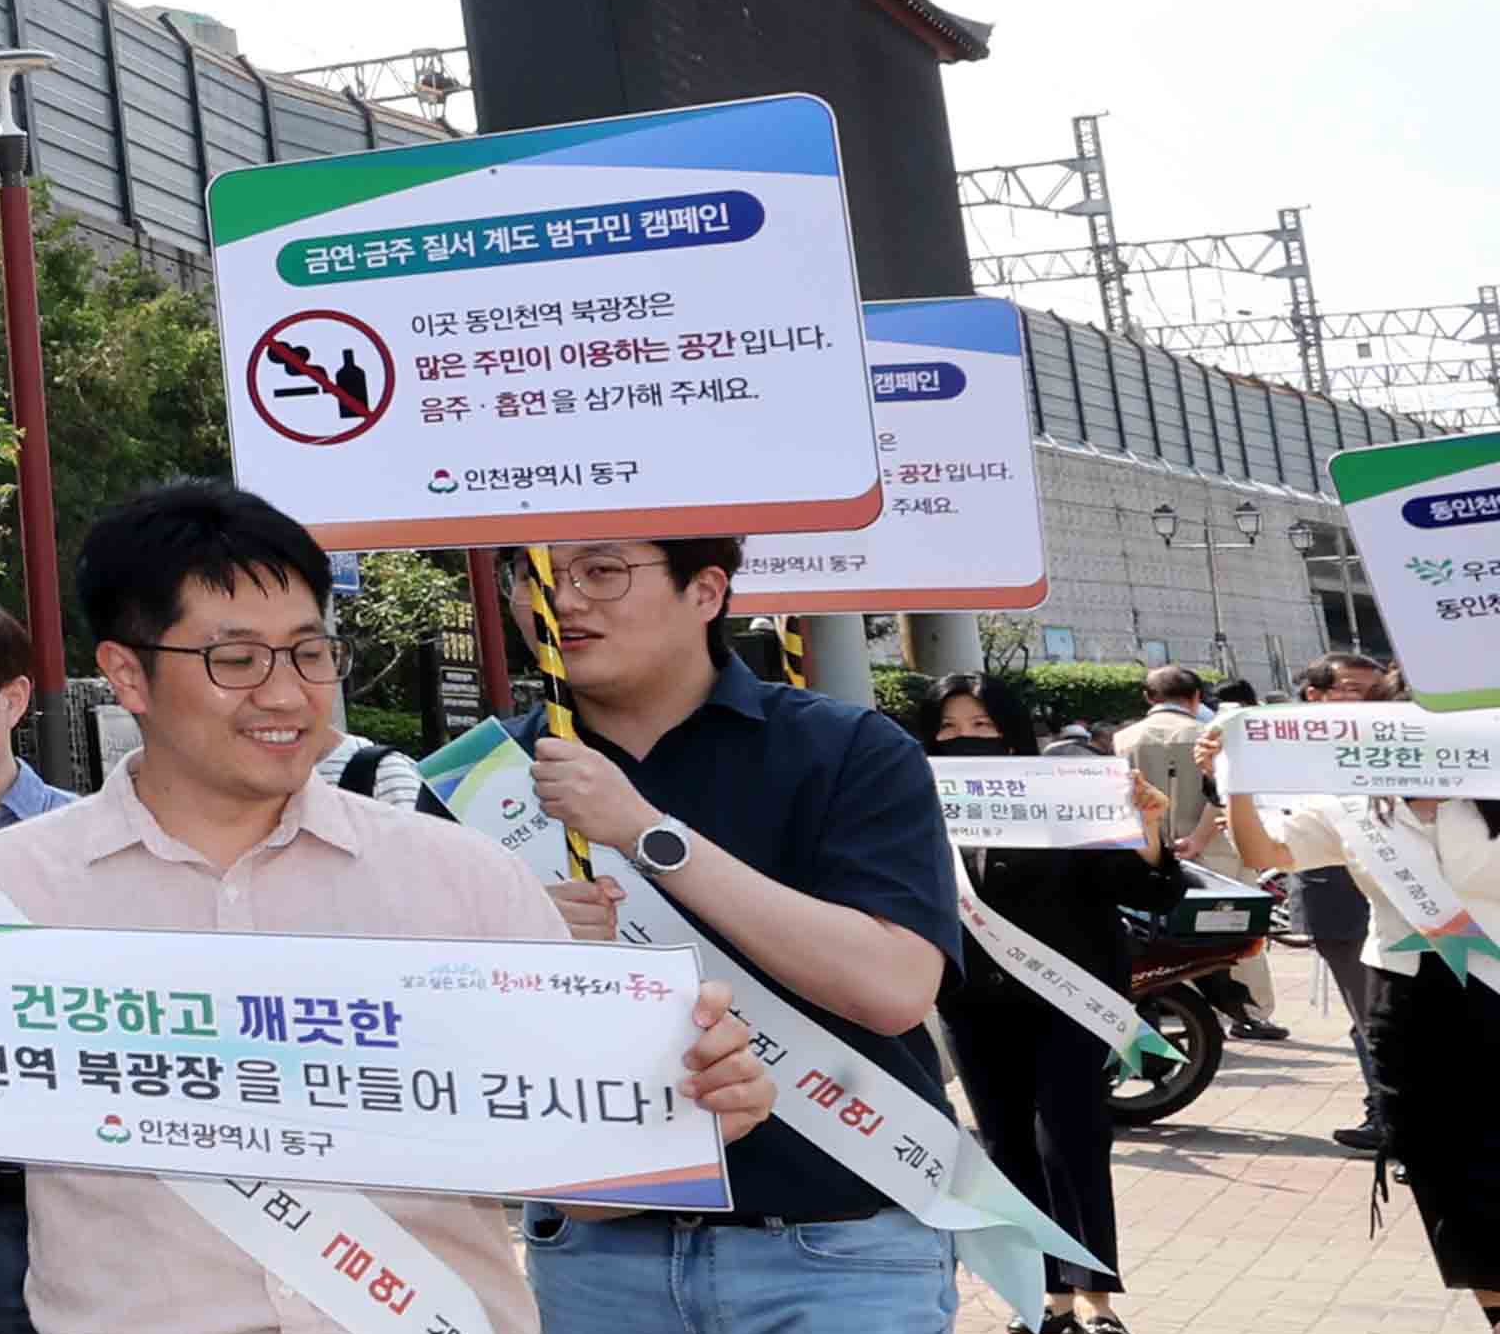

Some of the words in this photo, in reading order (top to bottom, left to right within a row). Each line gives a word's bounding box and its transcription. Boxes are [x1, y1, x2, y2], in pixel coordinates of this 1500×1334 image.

[304, 227, 416, 275] 금연·금주
[421, 223, 475, 263] 질서
[483, 215, 538, 255] 계도
[545, 207, 634, 250] 범구민
[640, 201, 730, 240] 캠페인
[411, 308, 457, 338] 이곳
[465, 300, 565, 336] 동인천역
[570, 291, 676, 329] 북광장은
[415, 349, 466, 382] 많은
[473, 342, 552, 378] 주민이
[559, 334, 671, 371] 이용하는
[419, 394, 470, 425] 음주
[584, 378, 664, 415] 삼가해
[671, 373, 761, 408] 주세요.
[874, 370, 940, 394] 캠페인
[464, 461, 583, 493] 인천광역시
[589, 458, 640, 487] 동구
[892, 498, 958, 517] 주세요.
[829, 554, 868, 572] 동구
[1244, 719, 1359, 742] 담배연기
[1372, 721, 1425, 742] 없는
[1335, 746, 1424, 769] 건강한
[1436, 748, 1491, 769] 인천
[965, 779, 1026, 797] 깨끗한
[991, 803, 1048, 820] 만들어
[11, 985, 218, 1038] 건강하고
[238, 992, 402, 1049] 깨끗한
[78, 1049, 280, 1103] 북광장을
[304, 1061, 456, 1115] 만들어
[482, 1069, 675, 1126] 갑시다!
[797, 1067, 883, 1137] 금연
[138, 1117, 271, 1155] 인천광역시
[282, 1125, 333, 1158] 동구
[321, 1231, 416, 1315] 금연
